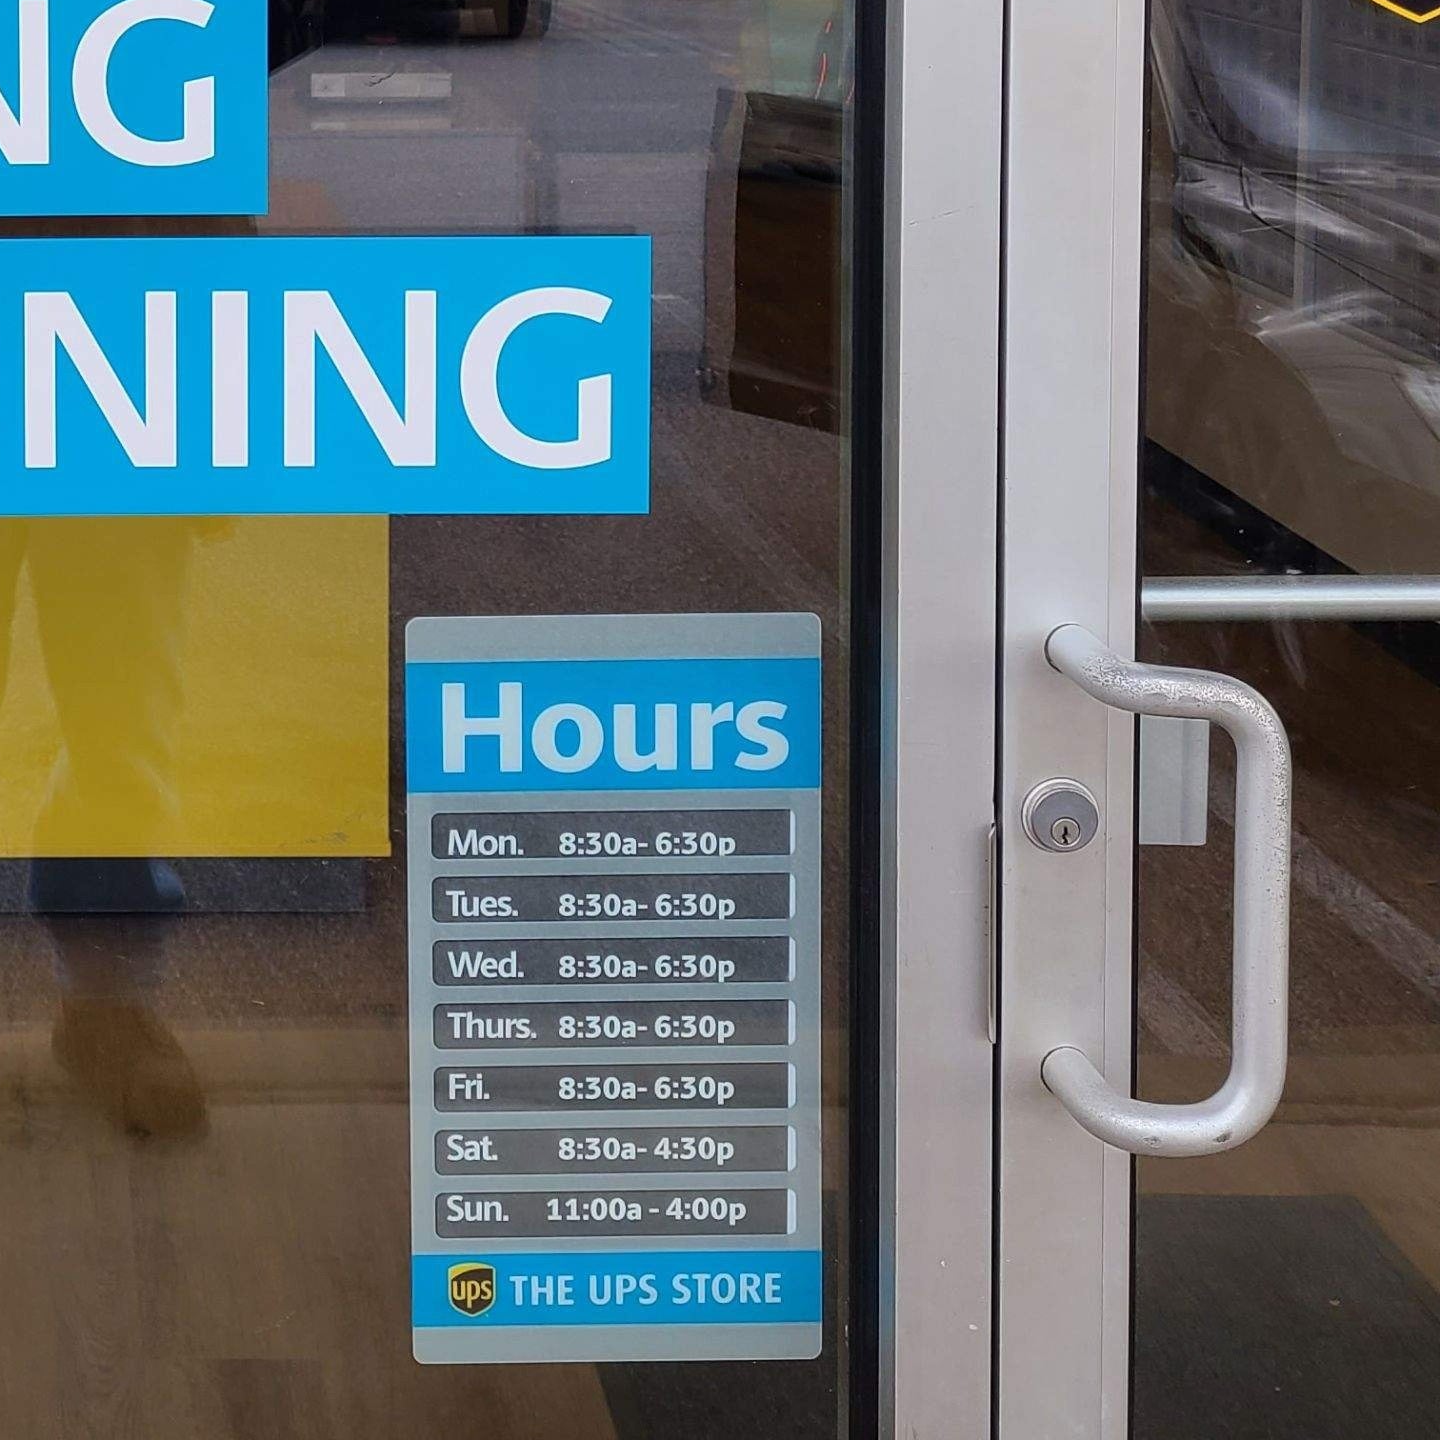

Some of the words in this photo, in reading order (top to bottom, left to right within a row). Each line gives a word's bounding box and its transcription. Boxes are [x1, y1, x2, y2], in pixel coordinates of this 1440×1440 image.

[441, 681, 790, 774] Hours
[447, 828, 524, 856] Mon.
[446, 890, 518, 917] Tues.
[447, 951, 524, 978] Wed.
[447, 1011, 537, 1039] Thurs.
[448, 1073, 490, 1100] Fri.
[447, 1135, 498, 1161] Sat.
[446, 1195, 510, 1222] Sun.
[452, 1279, 493, 1309] ups
[509, 1275, 574, 1306] THE
[590, 1274, 658, 1305] UPS
[672, 1273, 781, 1304] STORE
